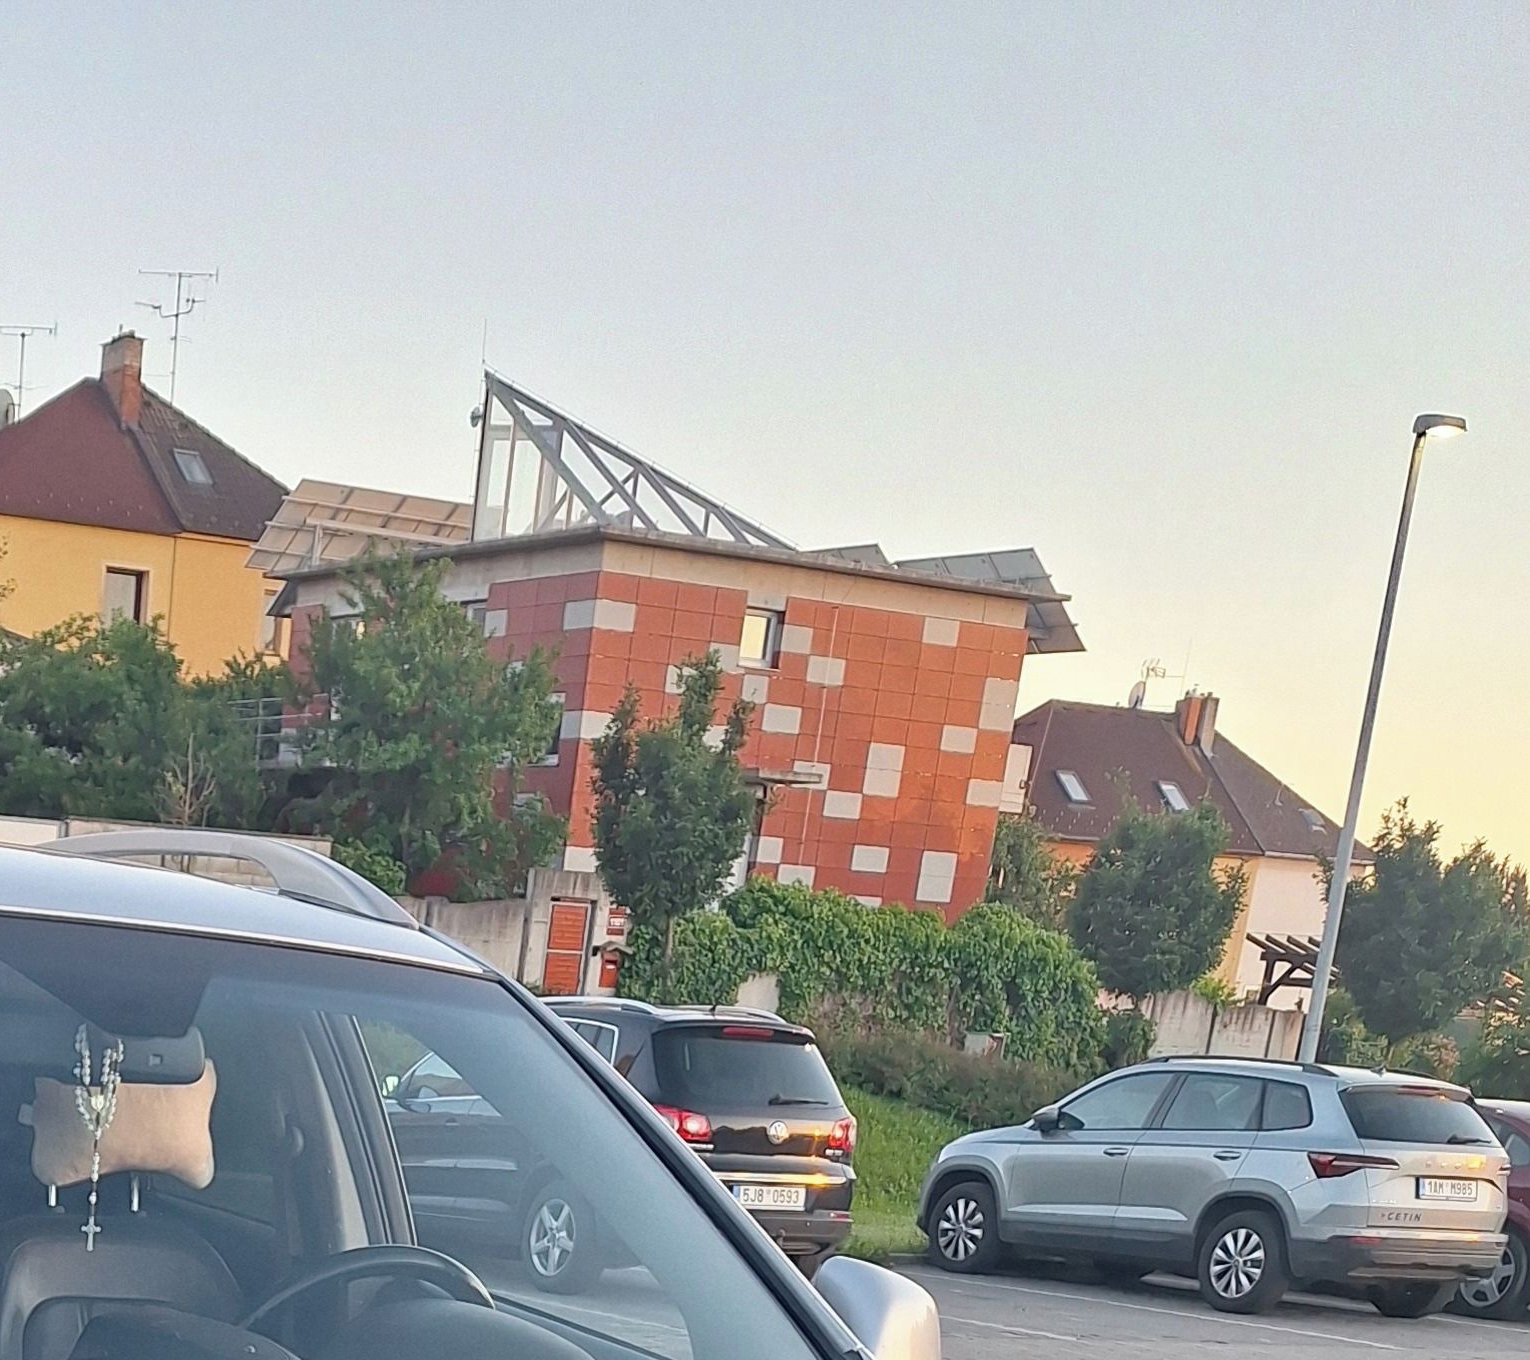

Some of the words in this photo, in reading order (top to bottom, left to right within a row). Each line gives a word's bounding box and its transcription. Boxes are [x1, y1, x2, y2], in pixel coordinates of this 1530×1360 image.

[742, 1188, 764, 1202] 5J8
[772, 1189, 800, 1204] 0593
[1387, 1212, 1422, 1221] CETIN
